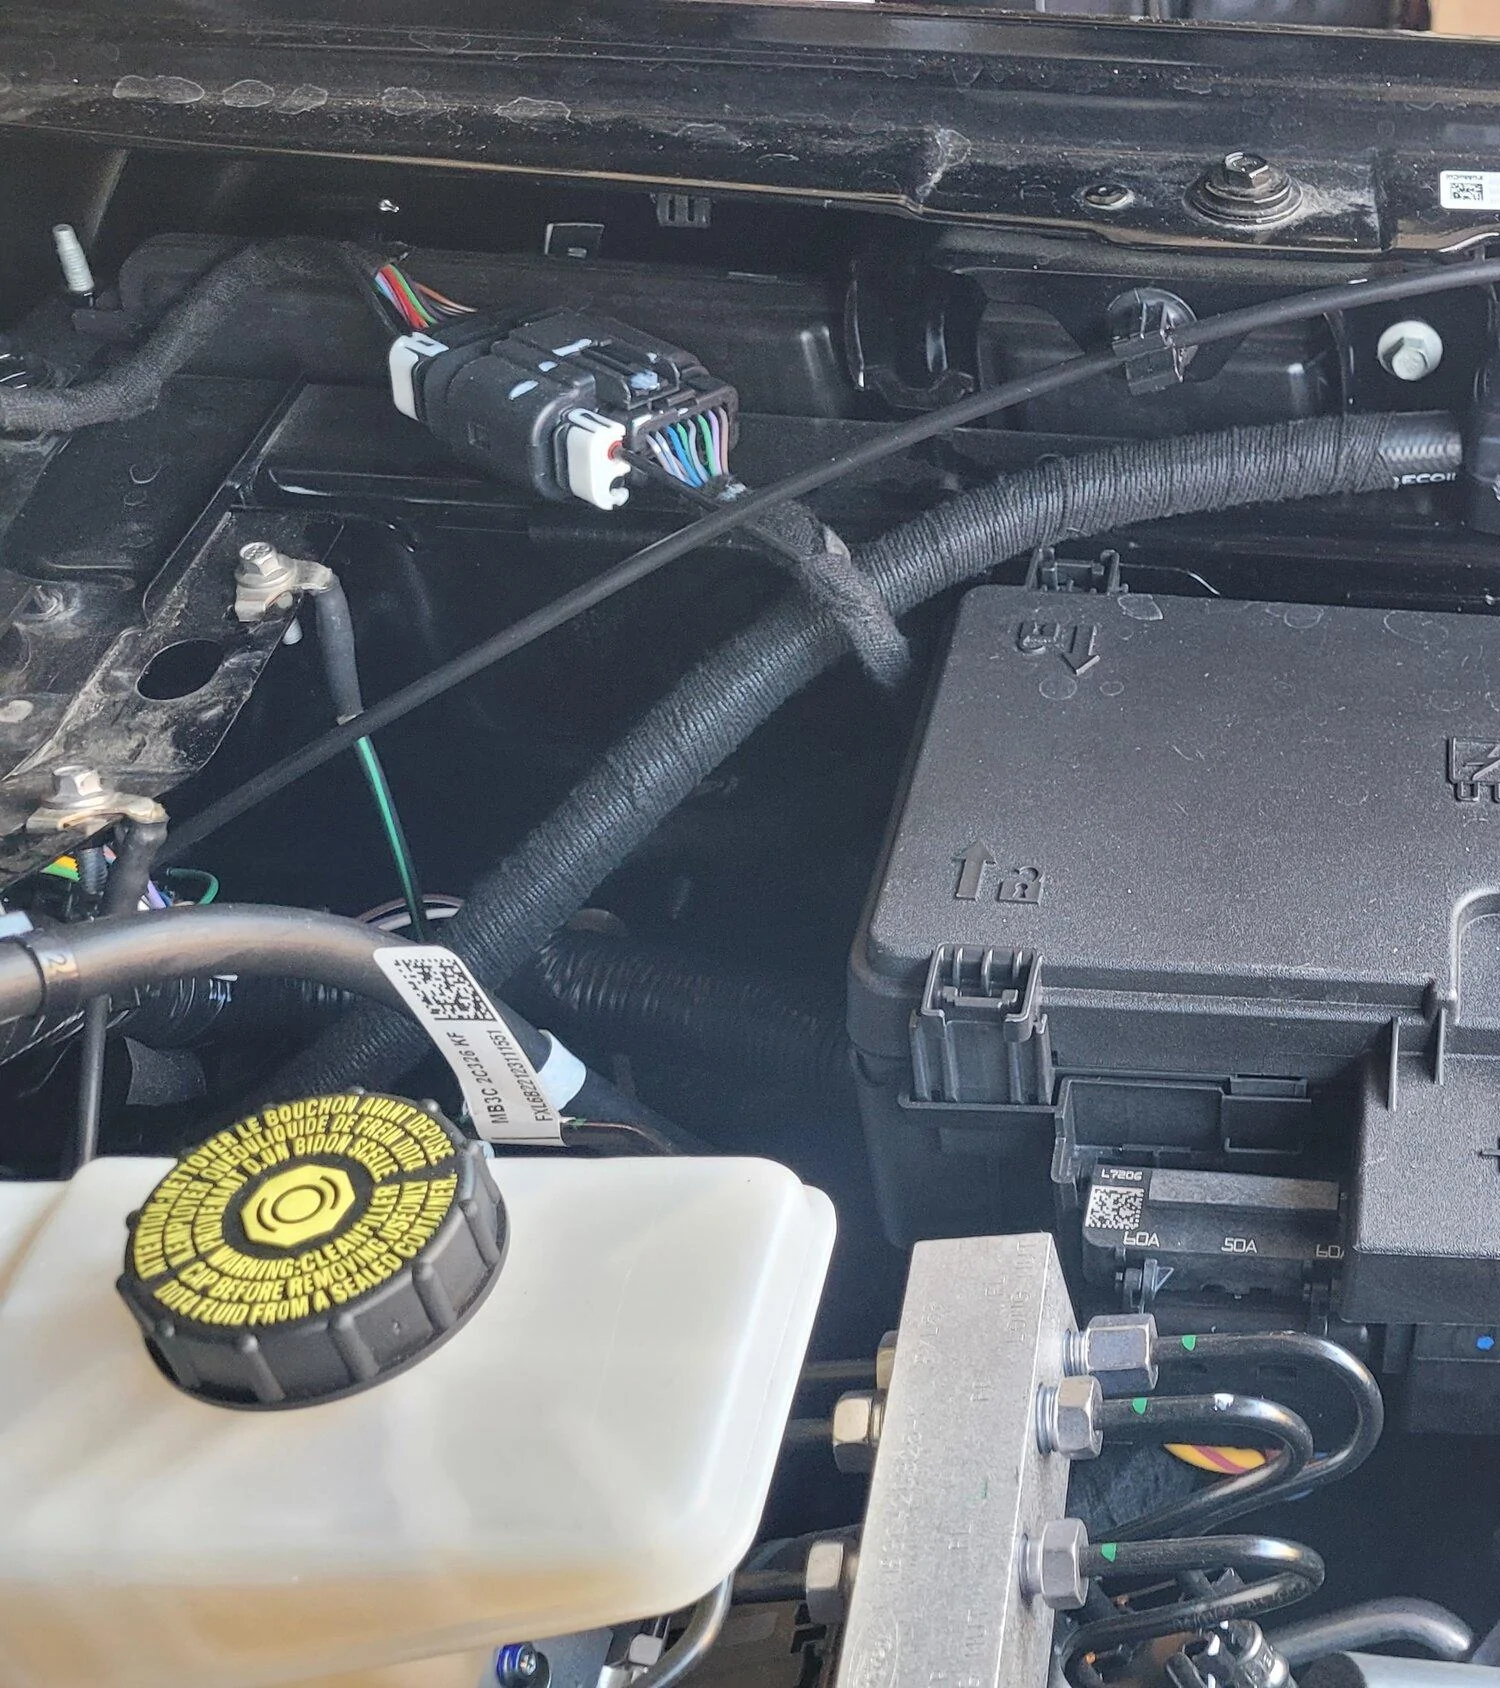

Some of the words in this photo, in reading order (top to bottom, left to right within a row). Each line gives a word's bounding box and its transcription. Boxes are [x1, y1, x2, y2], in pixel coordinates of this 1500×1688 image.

[447, 1032, 471, 1047] KF
[462, 1050, 494, 1085] 2C326
[235, 1116, 262, 1139] LE
[264, 1095, 360, 1127] BOUCHON
[358, 1097, 417, 1123] AVANT
[481, 1088, 510, 1124] MB3C
[294, 1133, 353, 1156] BIDON
[331, 1114, 358, 1134] DE
[354, 1116, 405, 1147] FREIN
[1123, 1231, 1161, 1248] 60A
[1221, 1237, 1258, 1254] 50A
[177, 1261, 219, 1291] CAP
[207, 1278, 286, 1302] BEFORE
[191, 1298, 250, 1326] FLUID
[247, 1295, 310, 1327] FROM
[312, 1290, 331, 1314] A
[330, 1252, 403, 1304] SEALED
